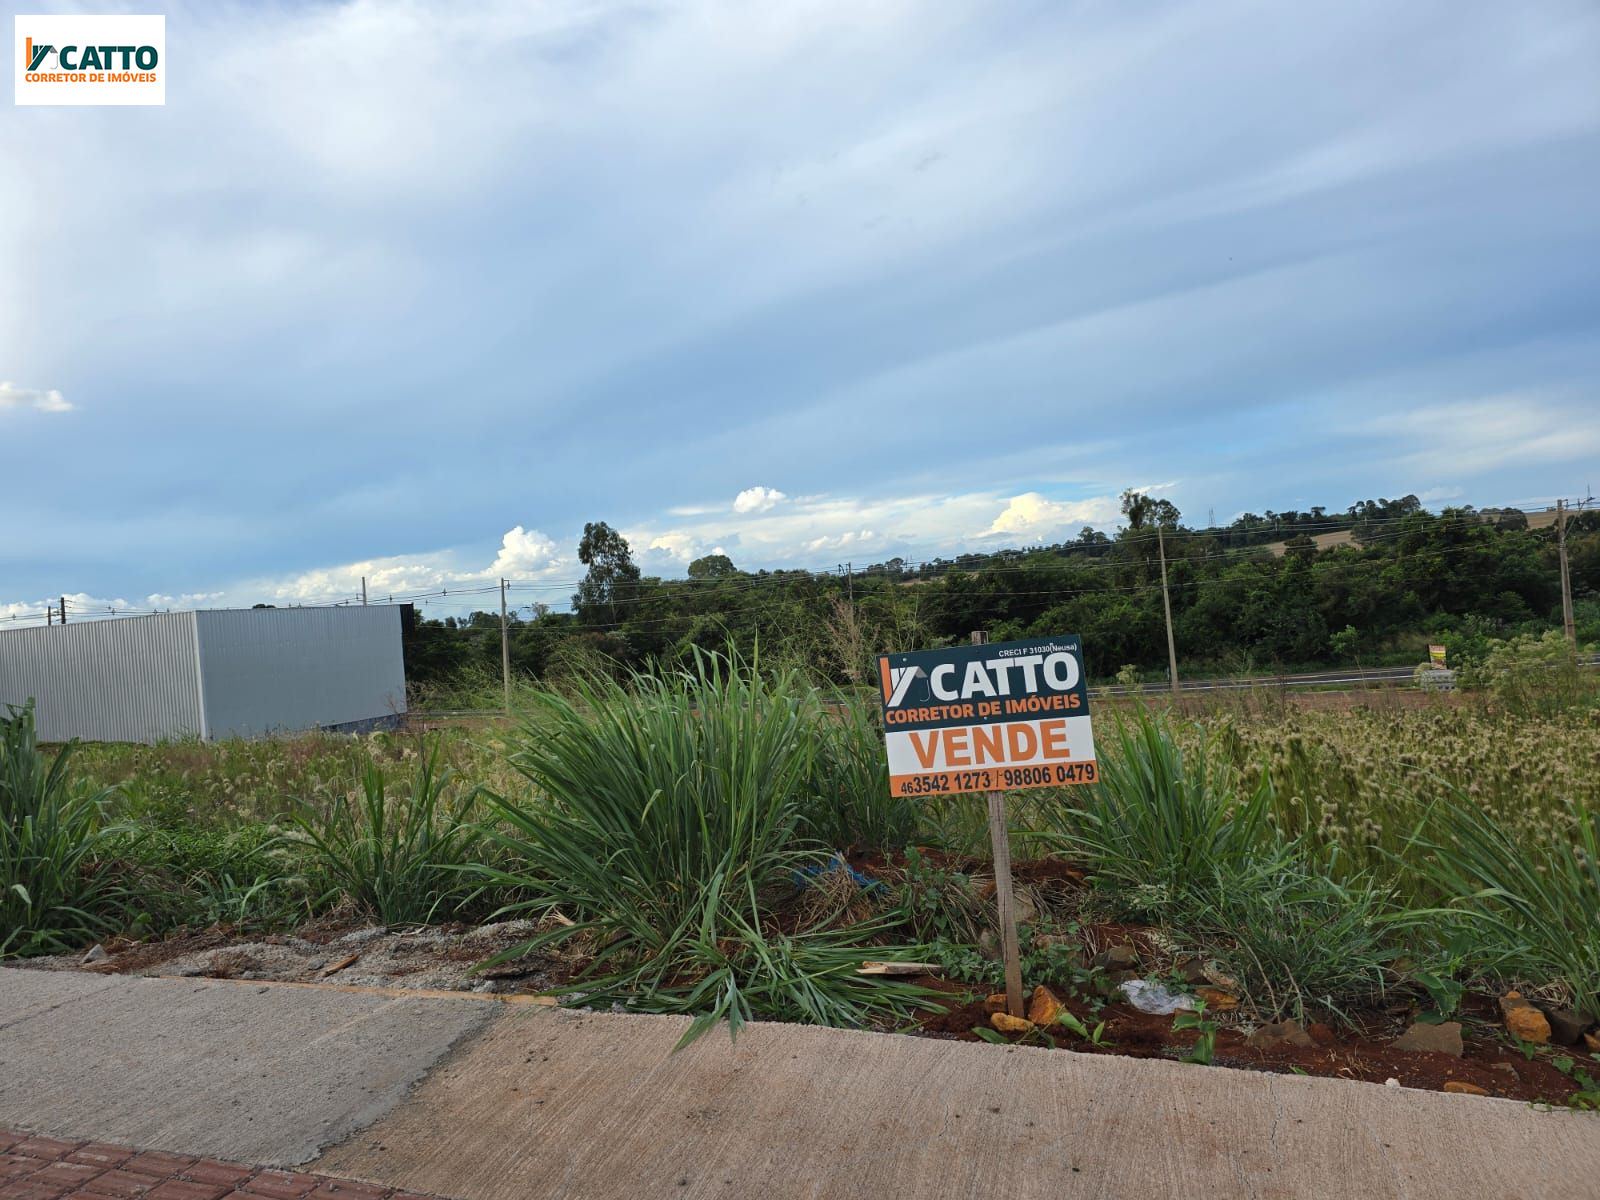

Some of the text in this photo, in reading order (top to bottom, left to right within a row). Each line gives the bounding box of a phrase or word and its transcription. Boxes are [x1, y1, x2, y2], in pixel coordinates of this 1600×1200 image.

[998, 648, 1022, 657] CRECI
[929, 652, 1080, 701] CATTO
[885, 693, 1081, 725] CORRETOR DE IMÓVEIS
[908, 719, 1071, 769] VENDE
[954, 771, 991, 791] 1273
[1056, 763, 1095, 783] 0479
